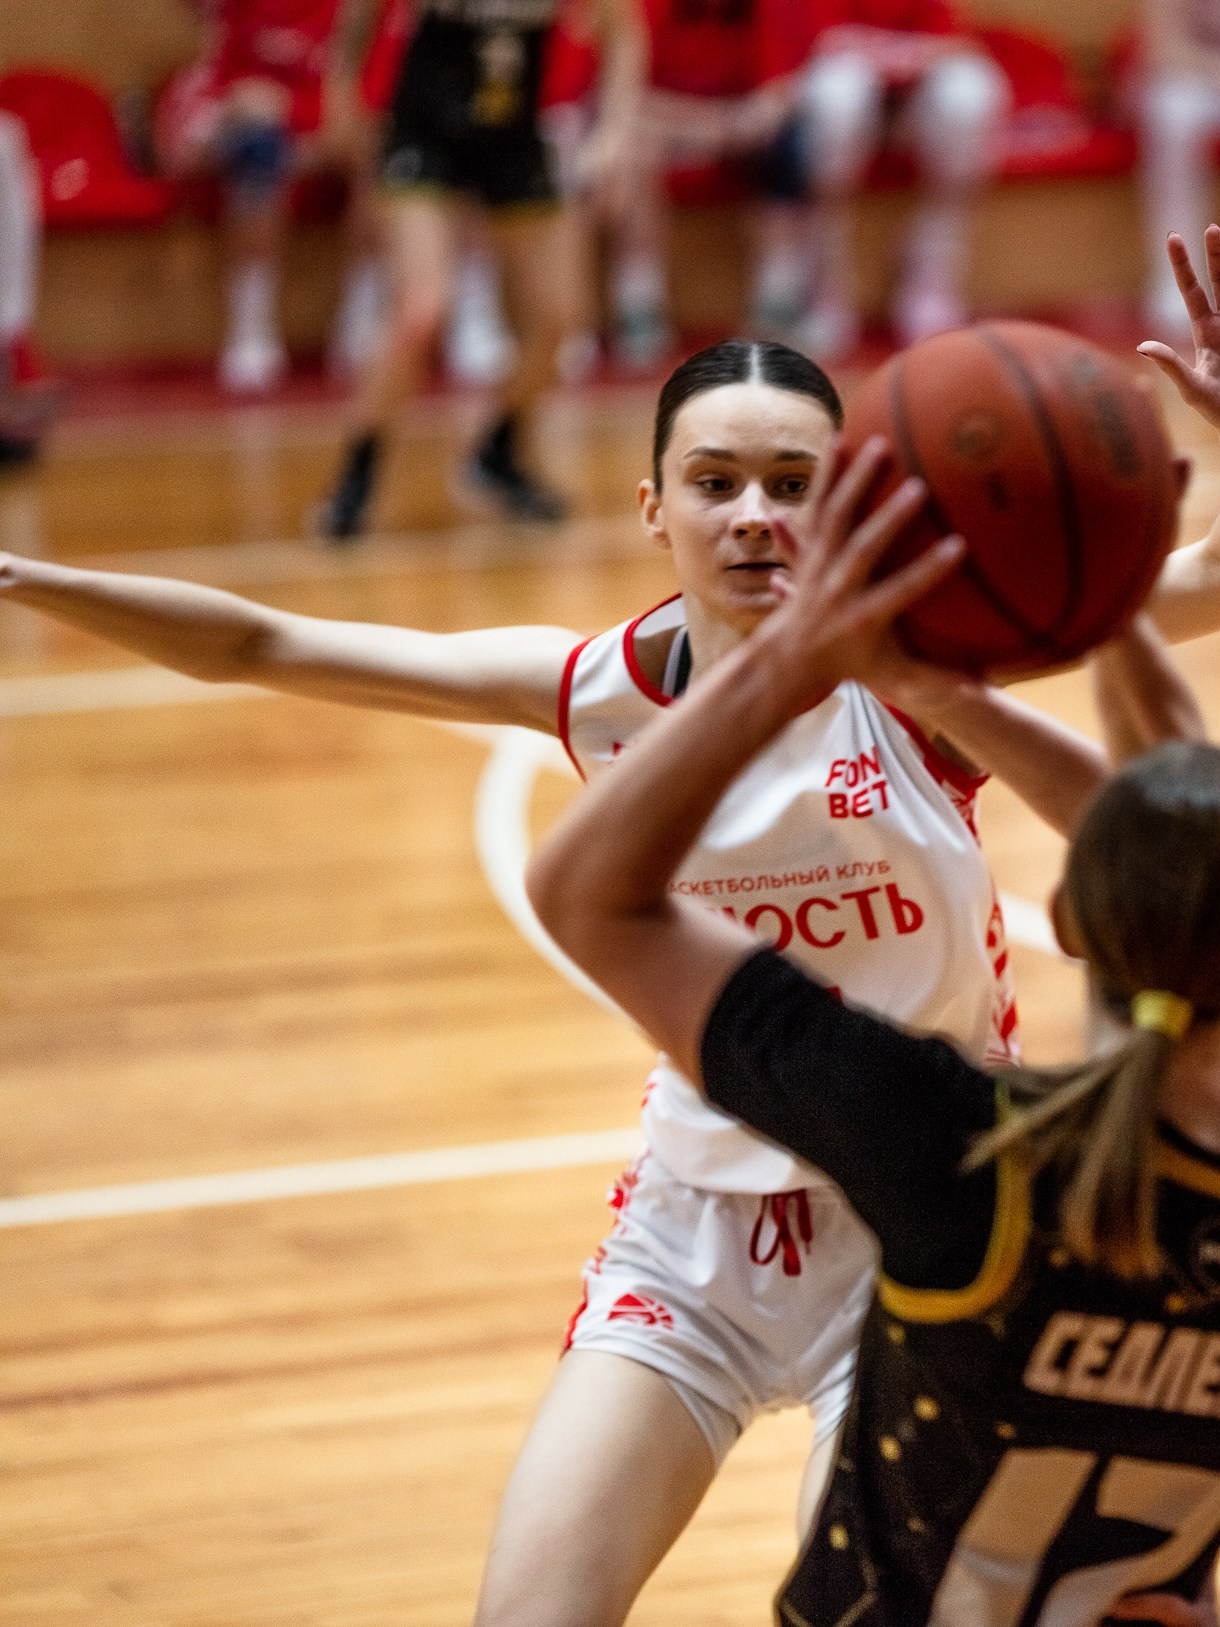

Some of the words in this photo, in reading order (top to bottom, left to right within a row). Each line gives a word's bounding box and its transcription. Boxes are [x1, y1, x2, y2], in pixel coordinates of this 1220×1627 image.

[824, 744, 881, 789] FON
[828, 780, 889, 819] BET
[835, 859, 891, 879] КЛУБ
[720, 882, 925, 953] ОСТЬ
